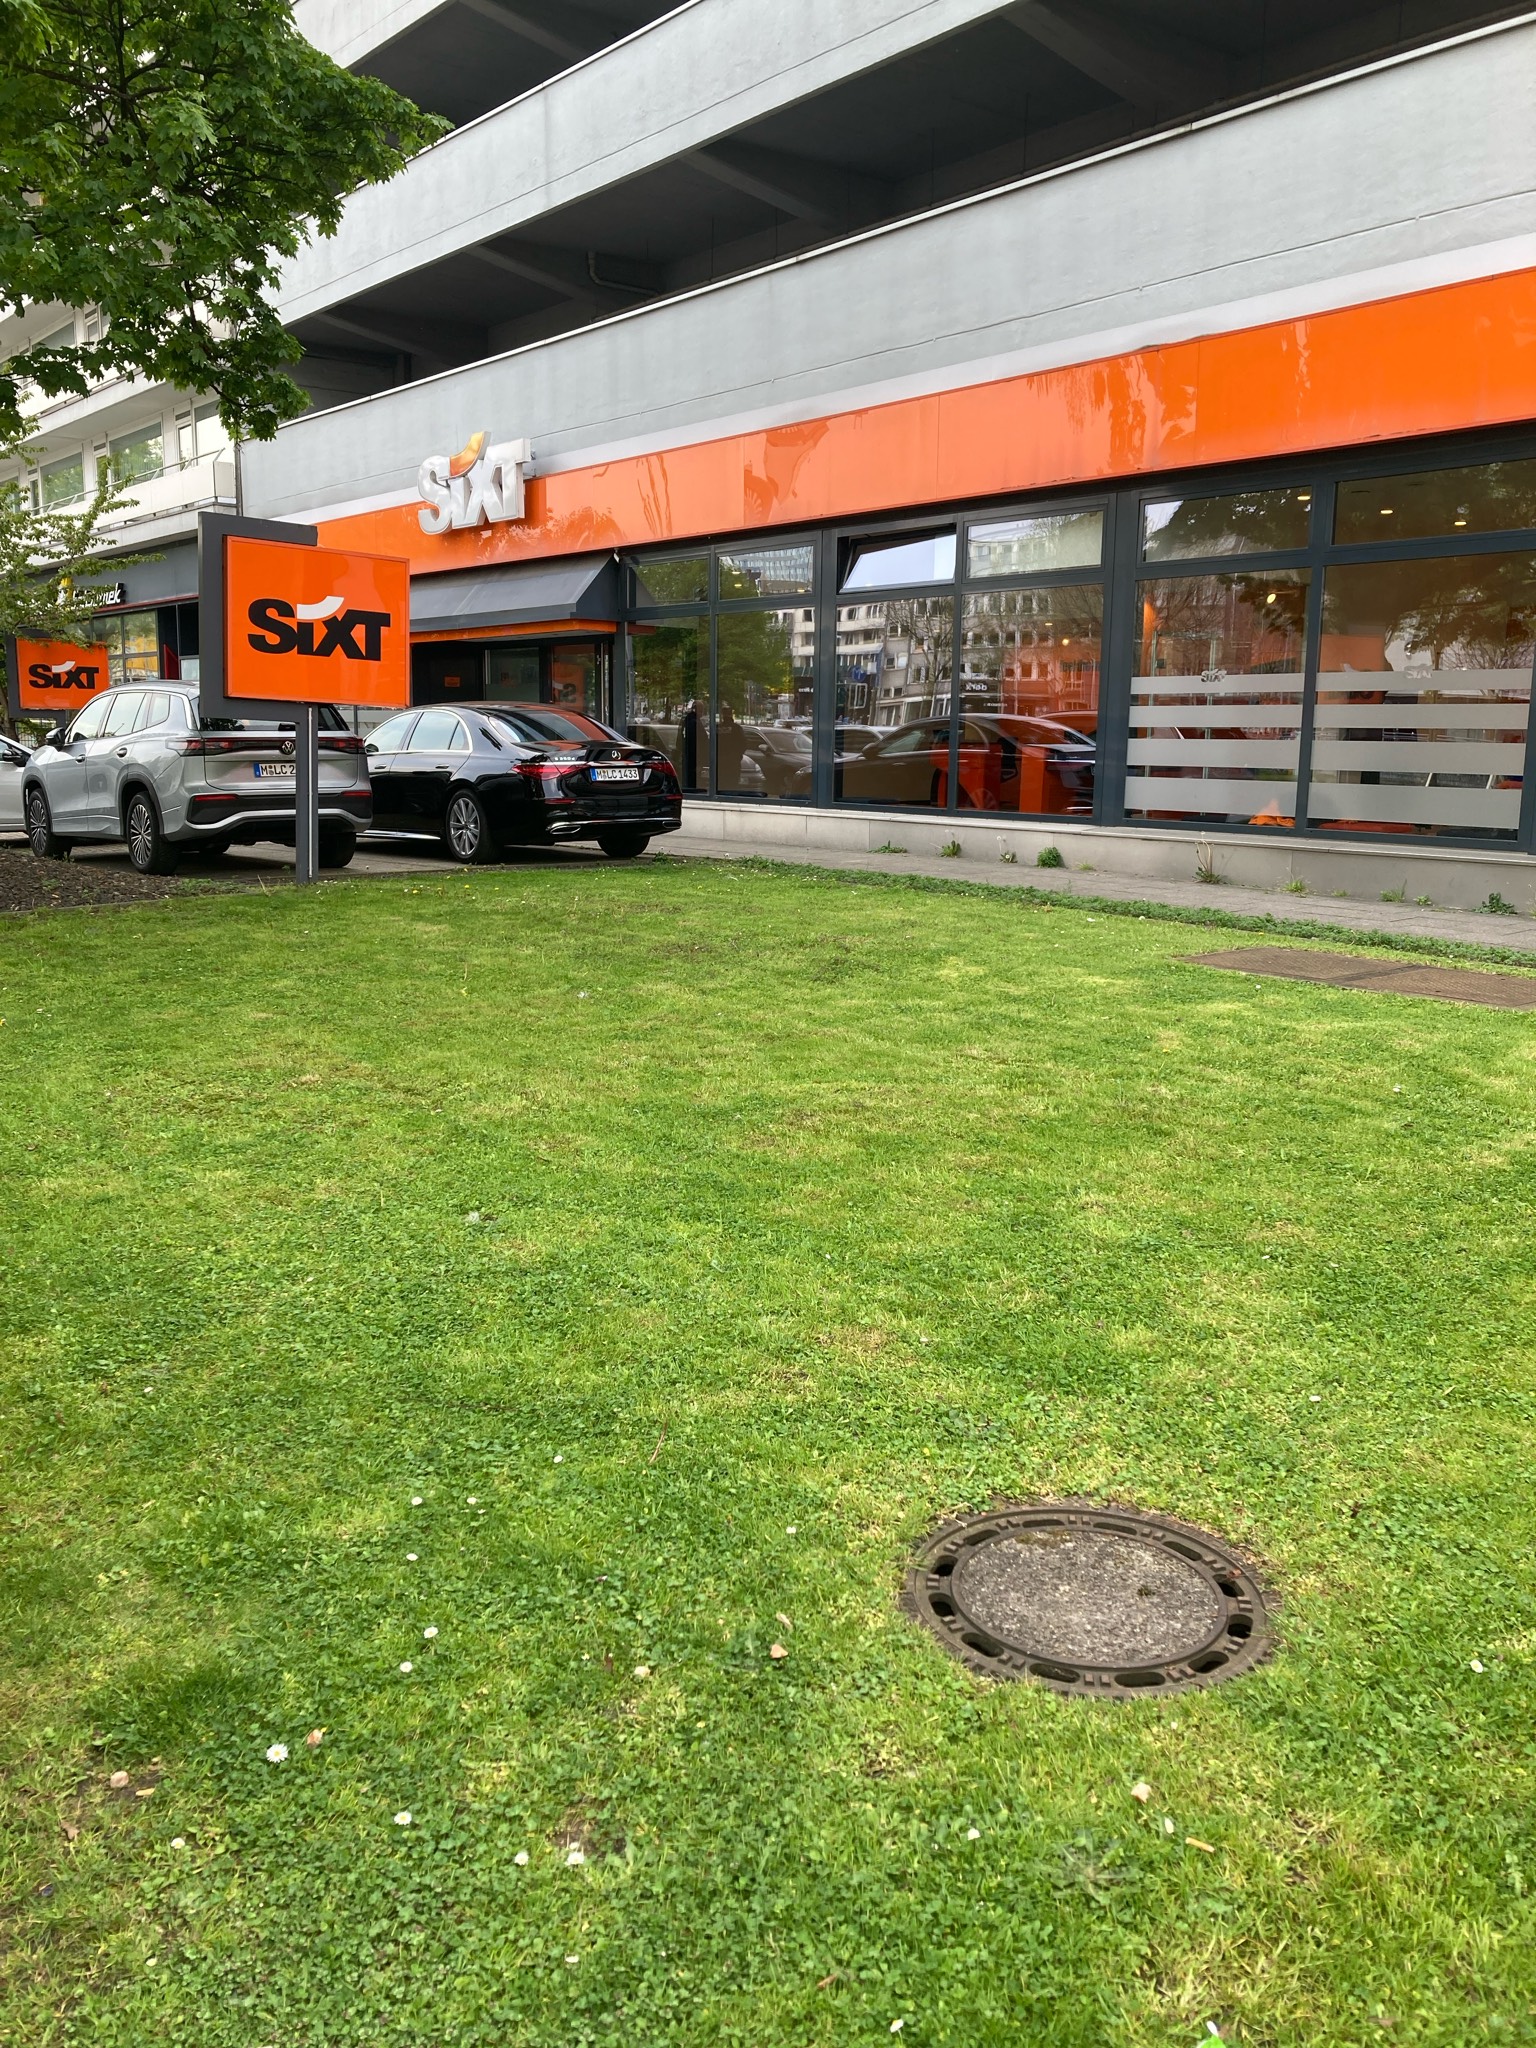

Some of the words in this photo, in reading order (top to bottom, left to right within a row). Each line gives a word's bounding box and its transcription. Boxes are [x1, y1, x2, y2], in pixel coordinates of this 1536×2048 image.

[261, 765, 268, 775] M
[274, 765, 287, 775] LC
[596, 770, 602, 778] M
[608, 769, 618, 778] LC
[619, 769, 637, 778] 1433
